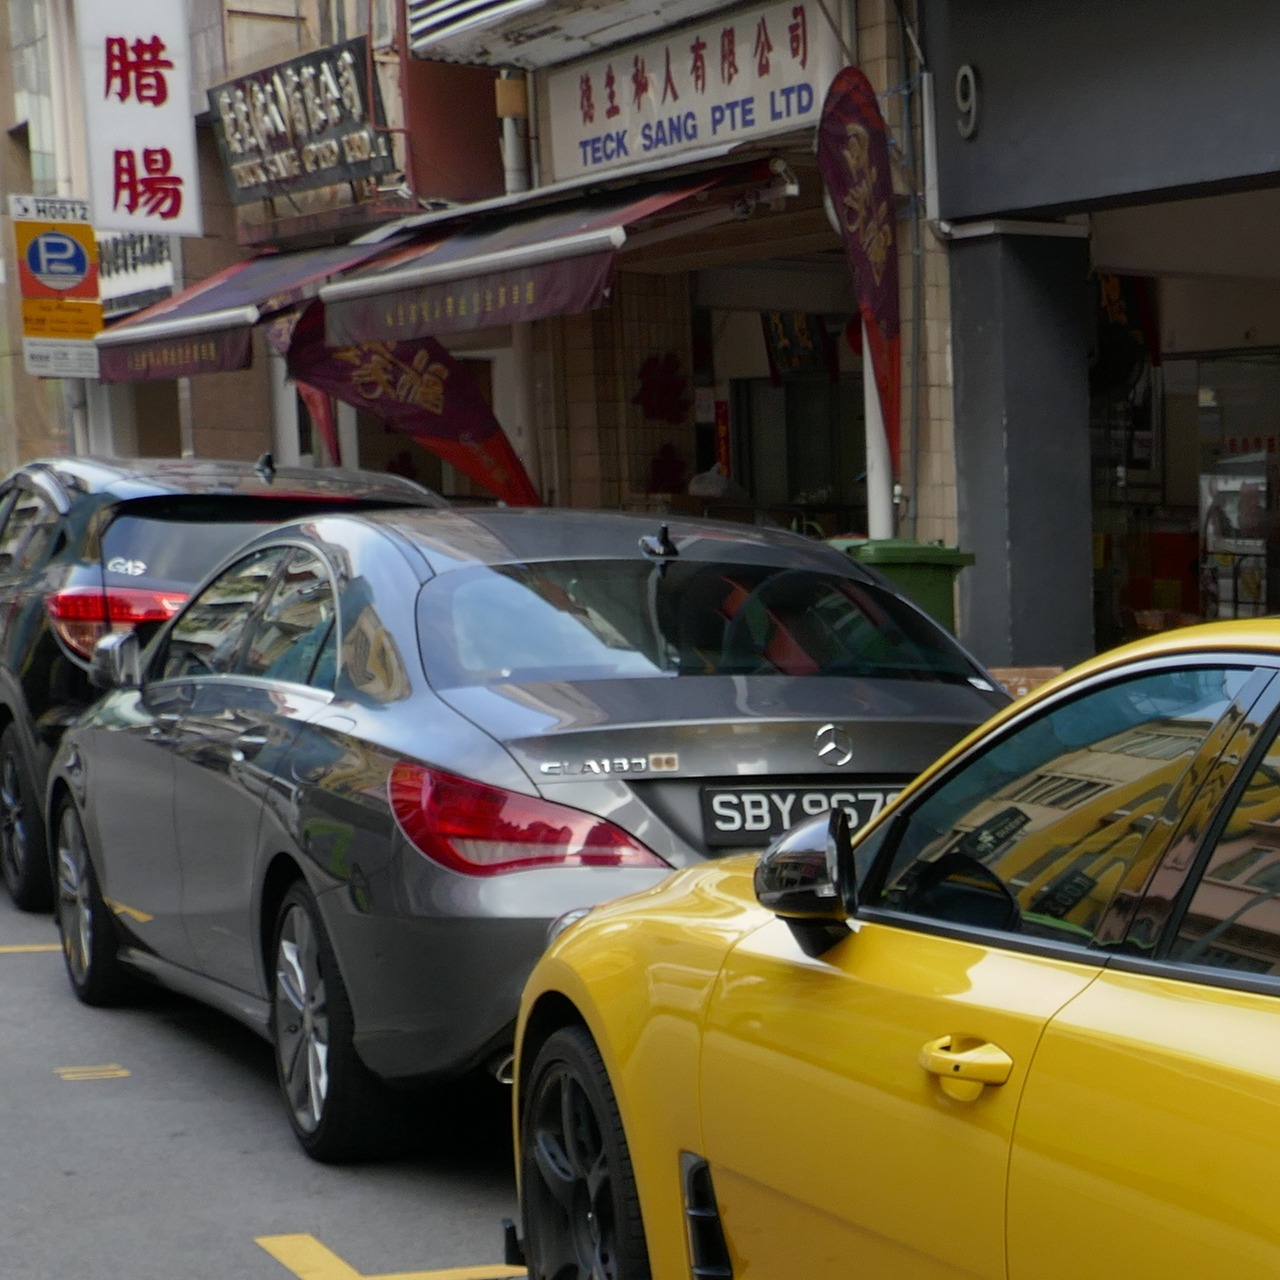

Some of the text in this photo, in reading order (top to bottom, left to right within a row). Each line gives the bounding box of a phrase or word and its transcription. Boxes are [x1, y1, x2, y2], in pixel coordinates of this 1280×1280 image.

[579, 83, 814, 166] TECK SANG PTE LTD
[955, 64, 977, 139] 9
[712, 792, 901, 831] SBY967
